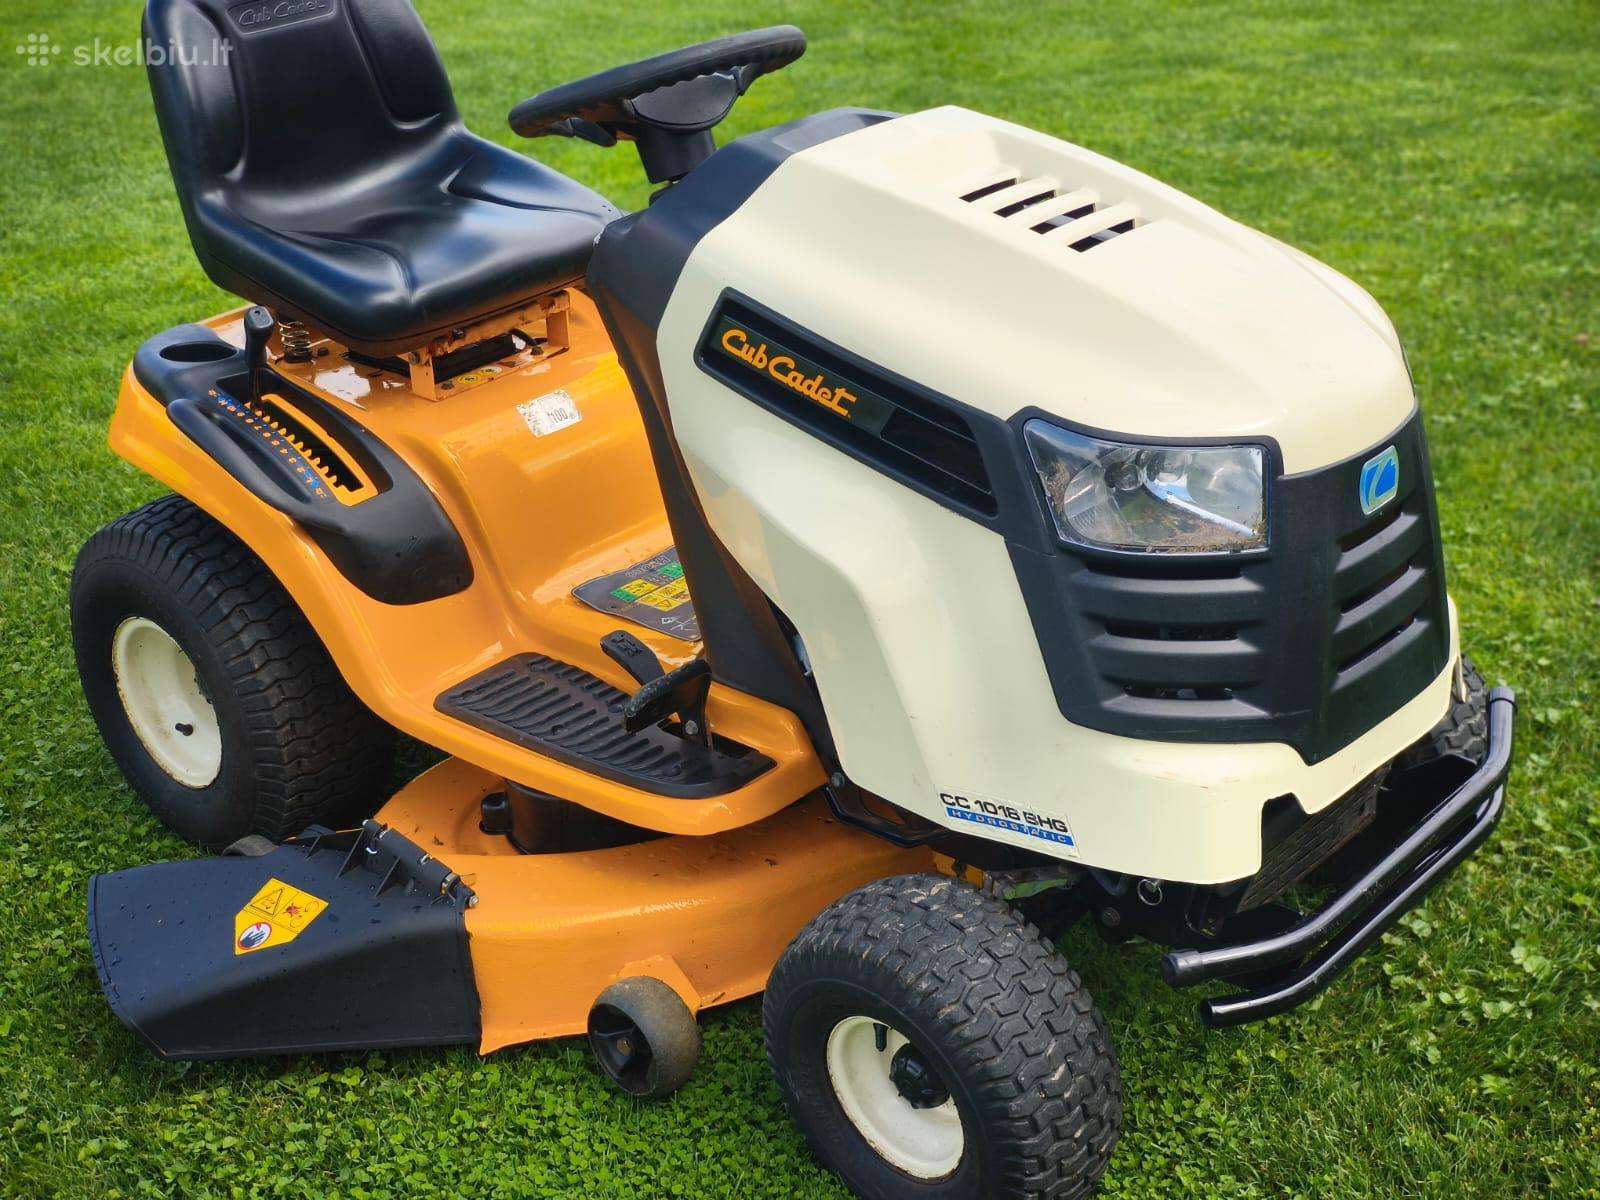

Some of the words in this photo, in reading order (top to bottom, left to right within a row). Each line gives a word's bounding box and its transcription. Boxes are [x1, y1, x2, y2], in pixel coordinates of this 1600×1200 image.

[239, 6, 272, 26] Cub
[721, 328, 768, 370] Cub
[768, 355, 857, 417] Cadet
[940, 792, 971, 810] CC
[974, 799, 1021, 821] 1016
[1022, 810, 1069, 833] BHG
[951, 810, 1068, 843] HYDROSTATIC
